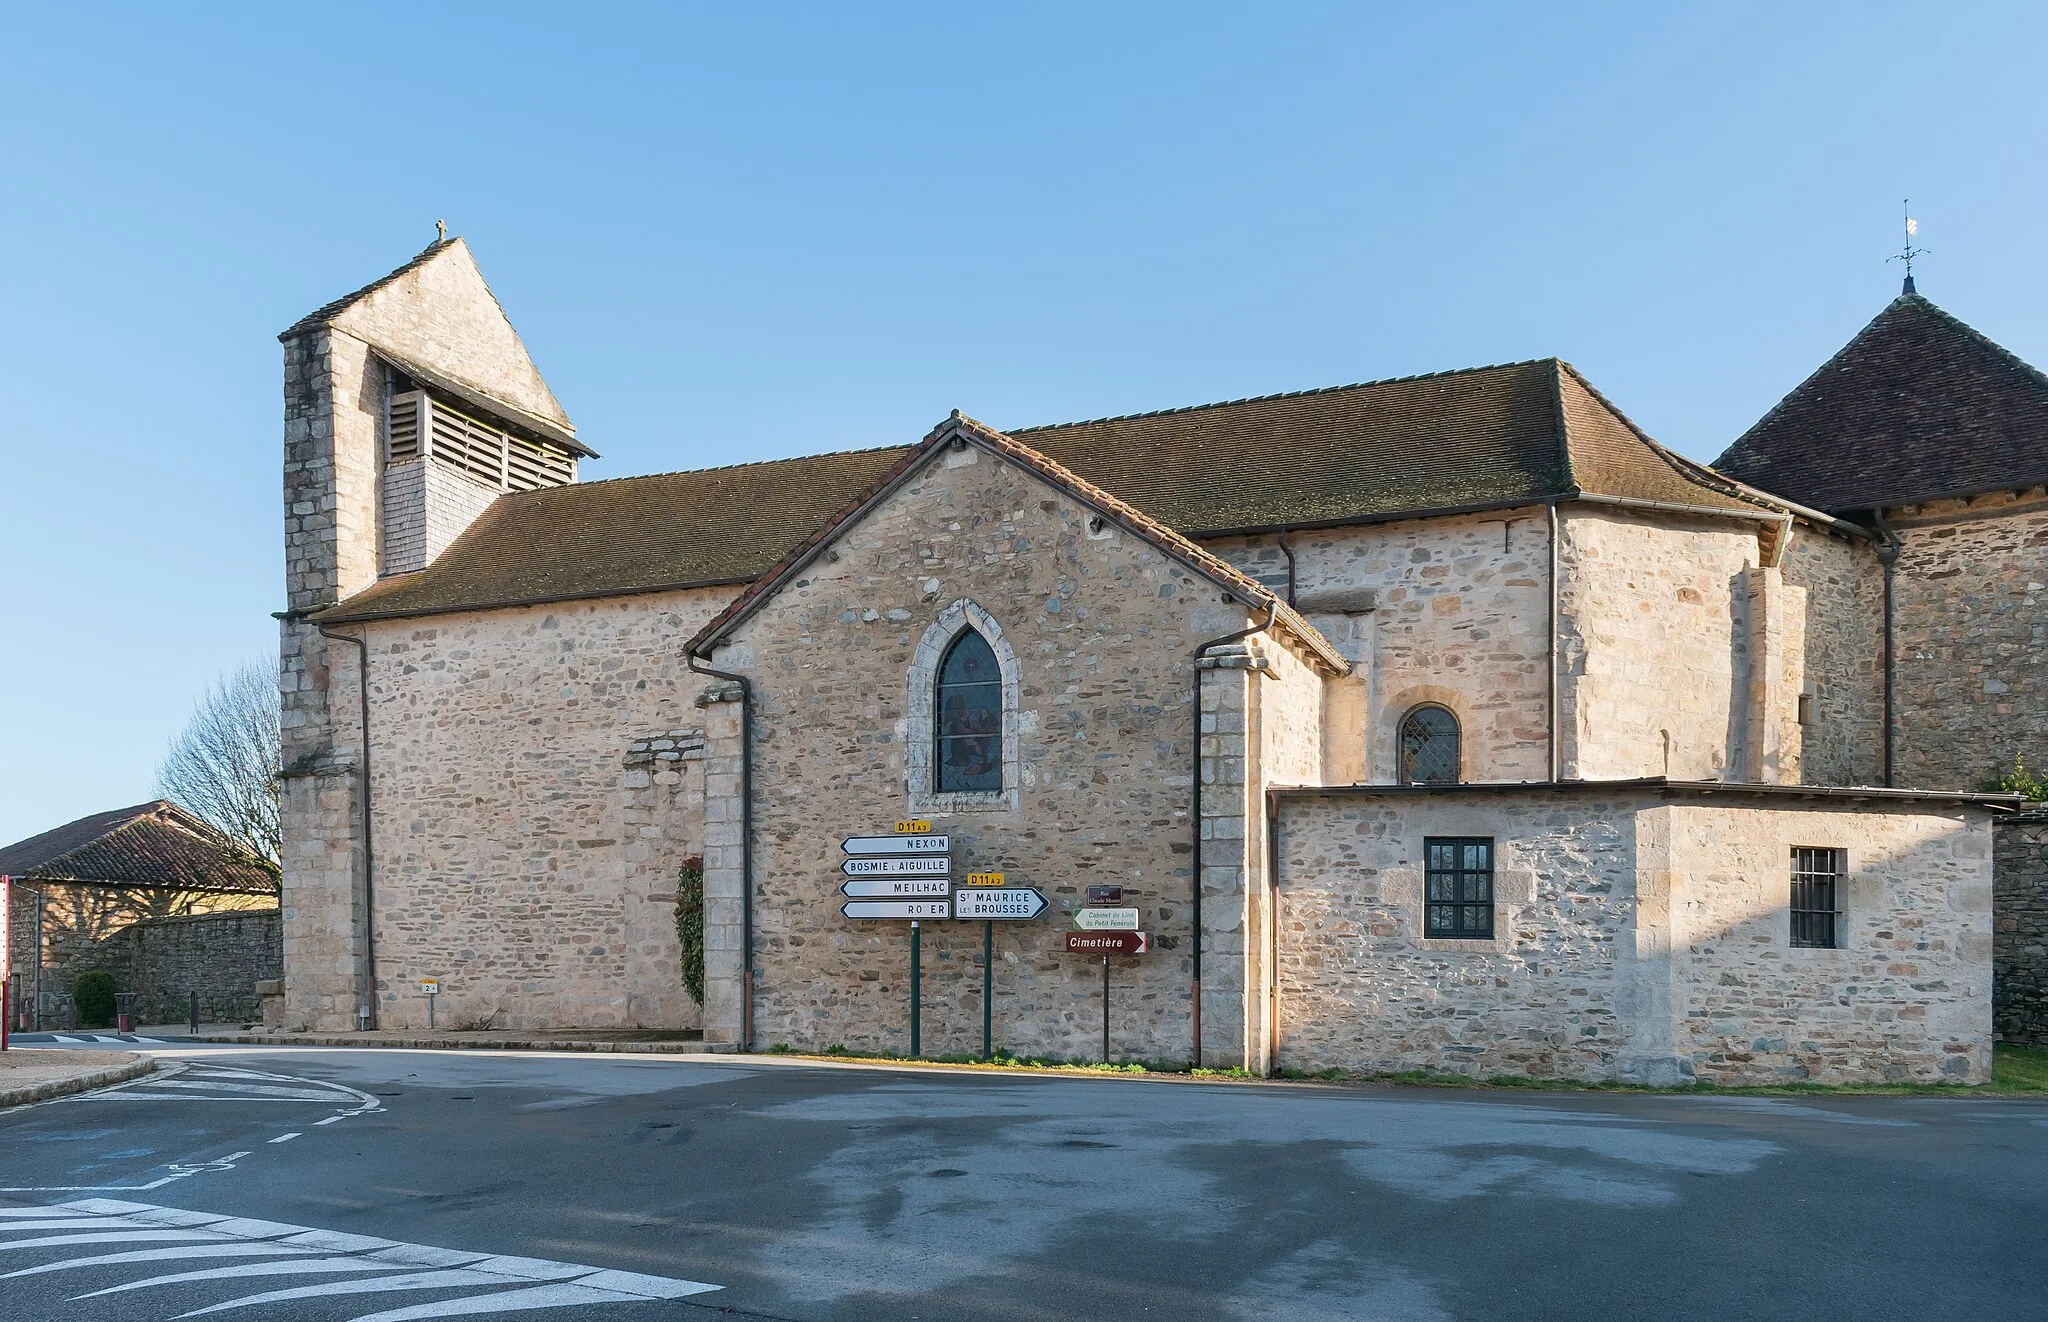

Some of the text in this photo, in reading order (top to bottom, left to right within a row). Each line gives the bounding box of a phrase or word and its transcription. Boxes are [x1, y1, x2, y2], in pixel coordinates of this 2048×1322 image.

[907, 839, 945, 849] NEXON
[850, 862, 888, 871] BOSMIE
[899, 861, 945, 870] AIGUILLE
[894, 883, 945, 892] MEILHAC
[976, 893, 1029, 902] MAURICE
[908, 905, 945, 914] ROER
[975, 905, 1029, 914] BROUSSES
[1070, 937, 1123, 947] Cimetière
